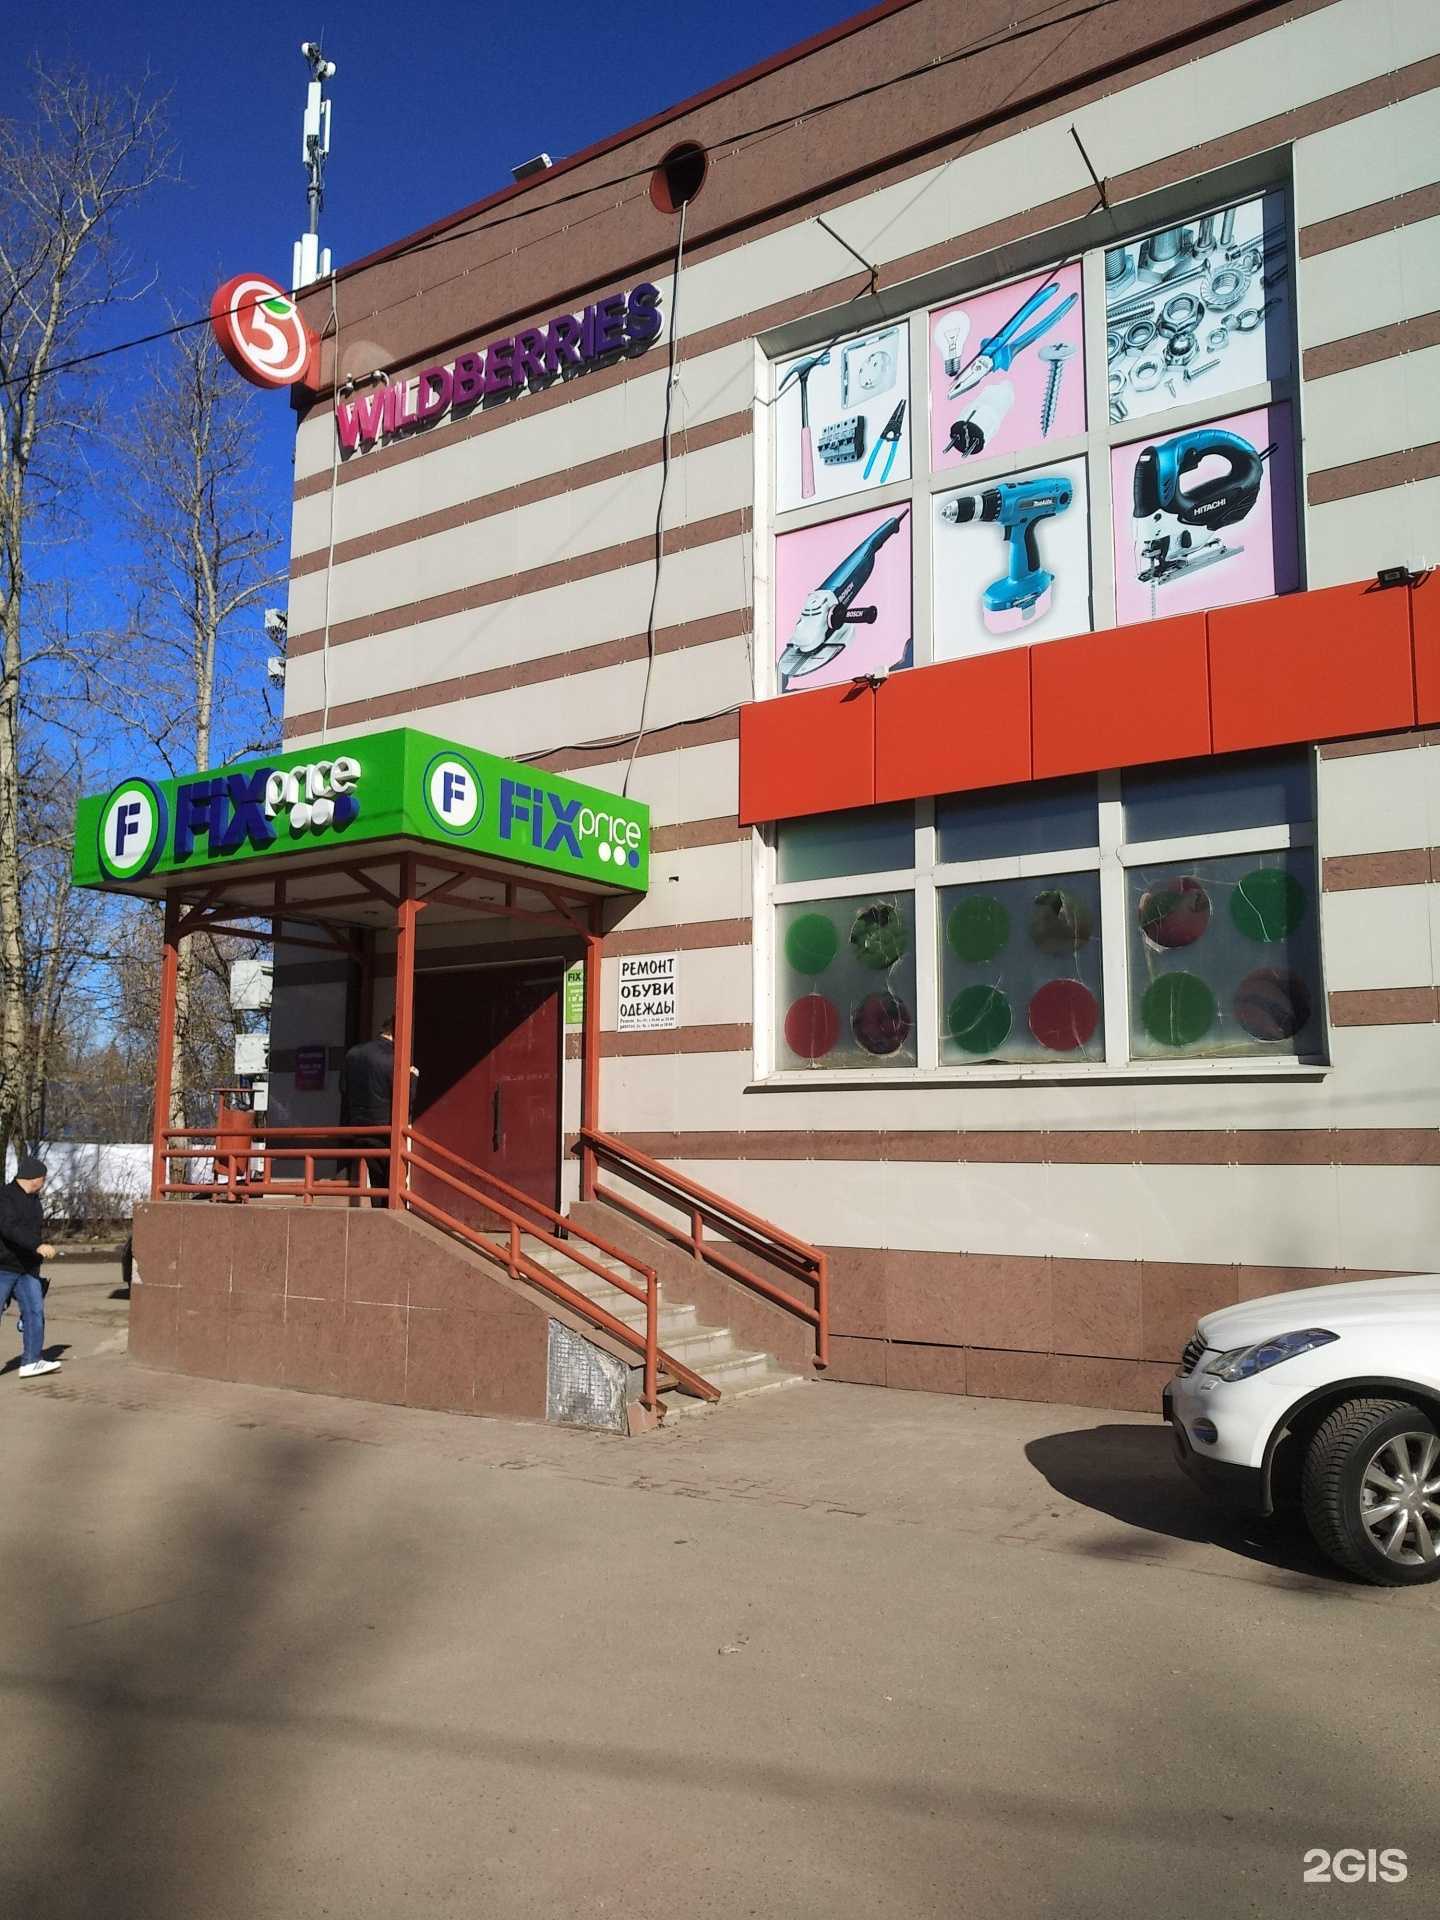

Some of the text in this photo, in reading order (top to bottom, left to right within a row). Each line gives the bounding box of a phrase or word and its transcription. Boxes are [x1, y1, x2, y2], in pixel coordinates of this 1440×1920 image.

[337, 282, 663, 448] WILDBERRIES
[1193, 497, 1227, 516] HITACHI
[846, 610, 864, 618] BOSCH
[443, 771, 466, 813] F
[115, 802, 142, 857] F
[579, 807, 642, 849] price
[622, 958, 675, 977] РЕМОНТ
[620, 982, 674, 999] ОБУВИ
[620, 1000, 675, 1017] ОДЕЖДЫ
